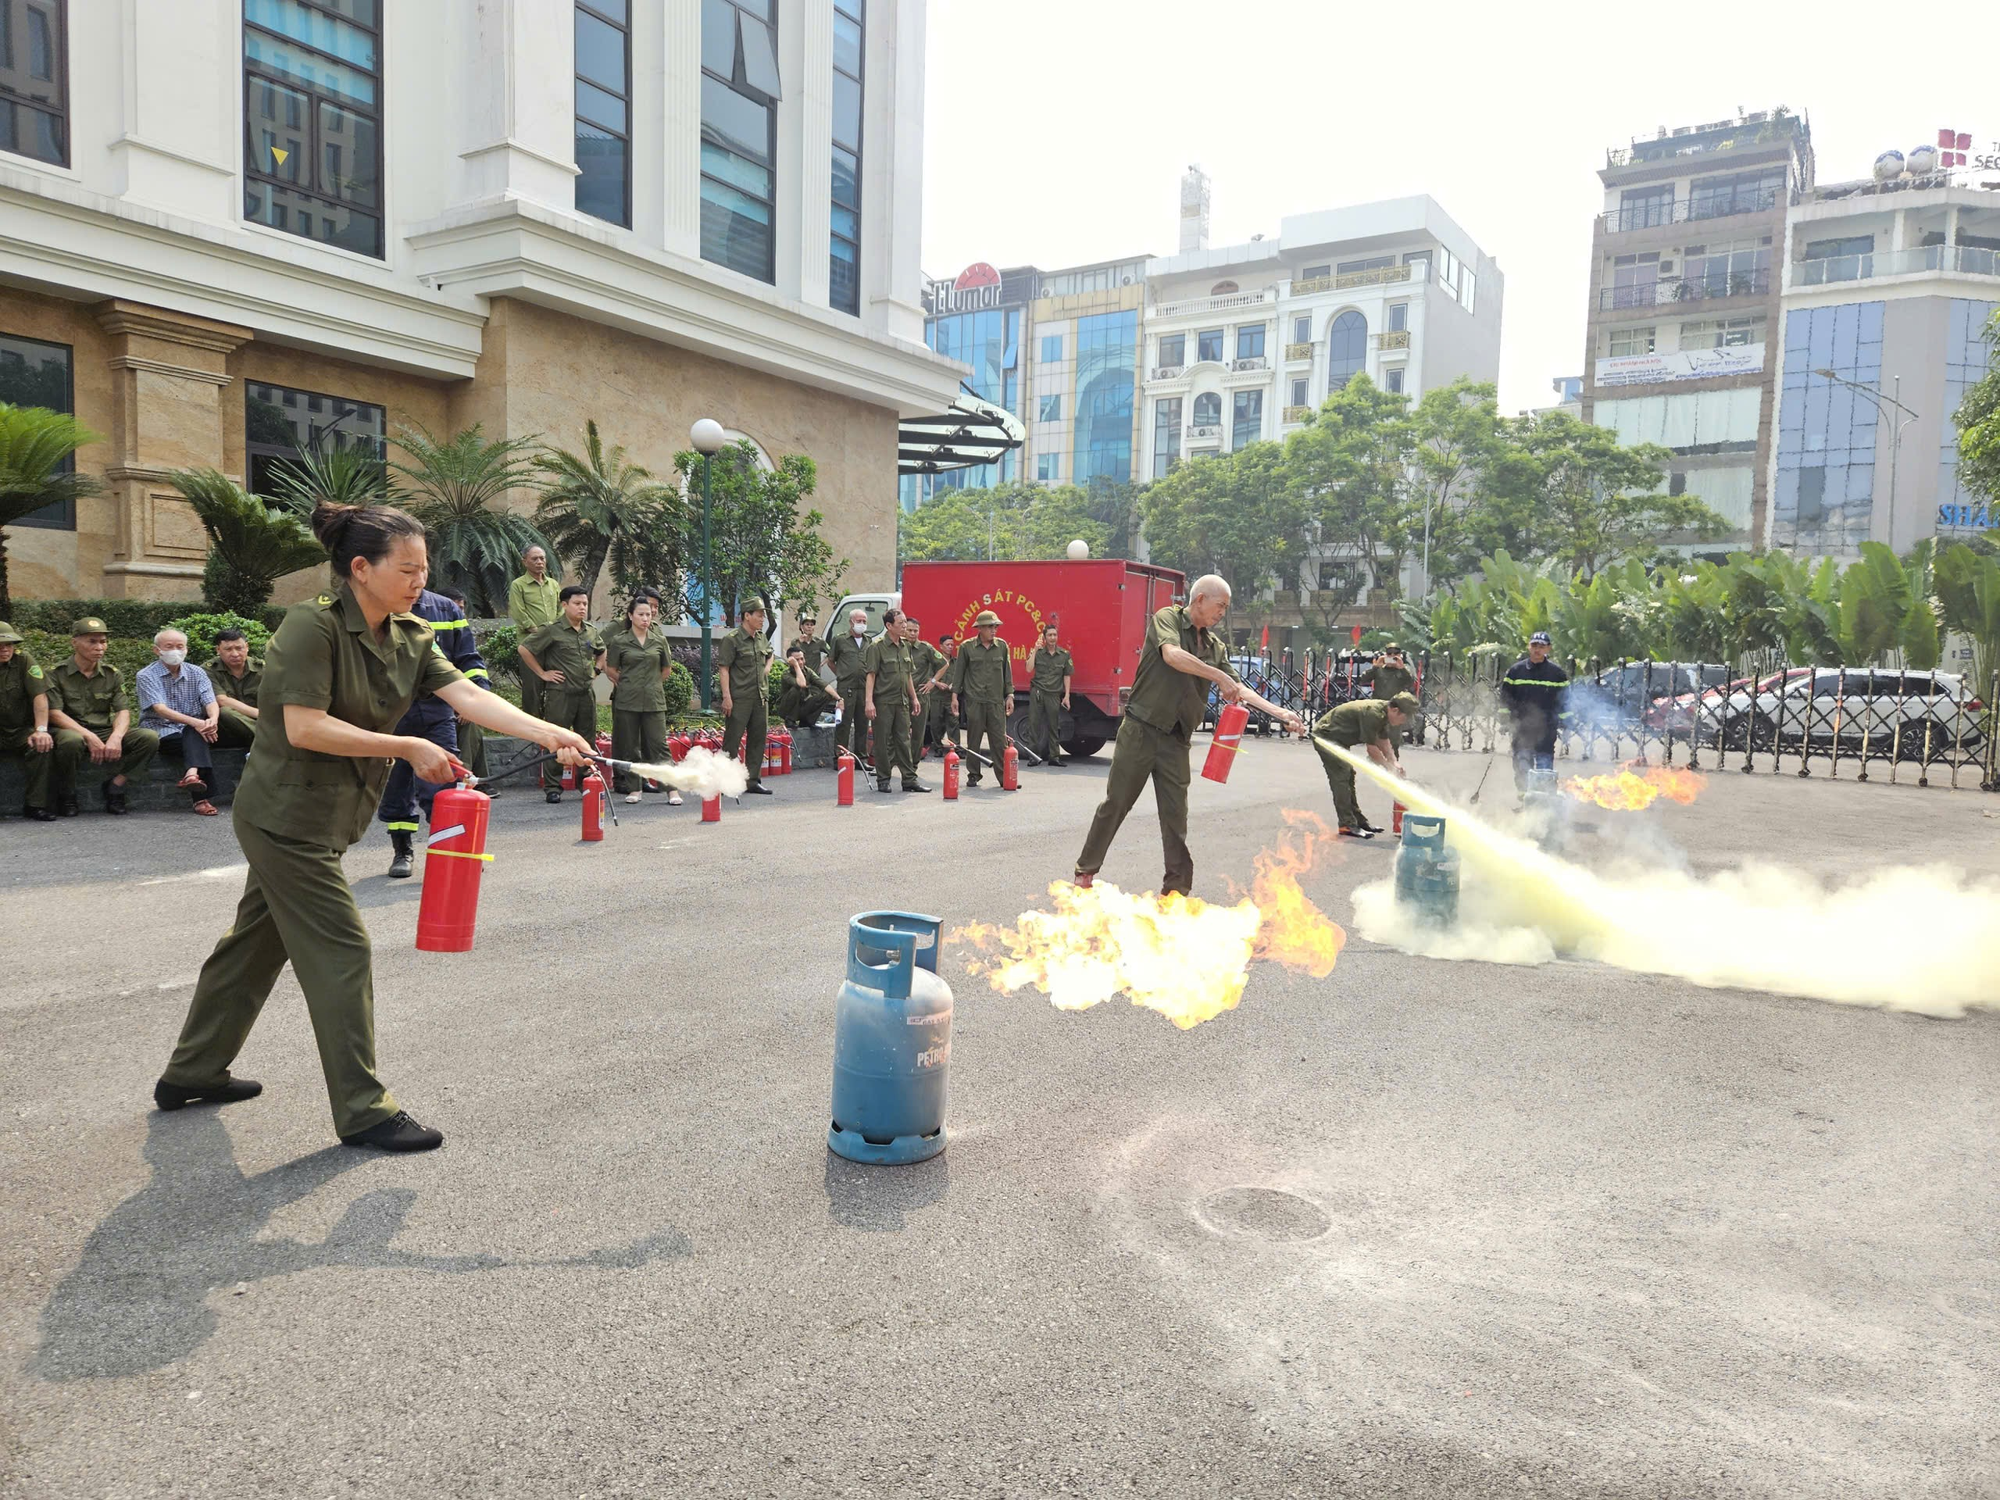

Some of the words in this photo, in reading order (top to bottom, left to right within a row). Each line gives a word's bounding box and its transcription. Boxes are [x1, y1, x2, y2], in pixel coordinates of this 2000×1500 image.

[954, 600, 980, 642] CẢNH
[983, 588, 1013, 605] SÁT
[1016, 594, 1046, 633] PC&C
[1013, 644, 1027, 660] HÀ
